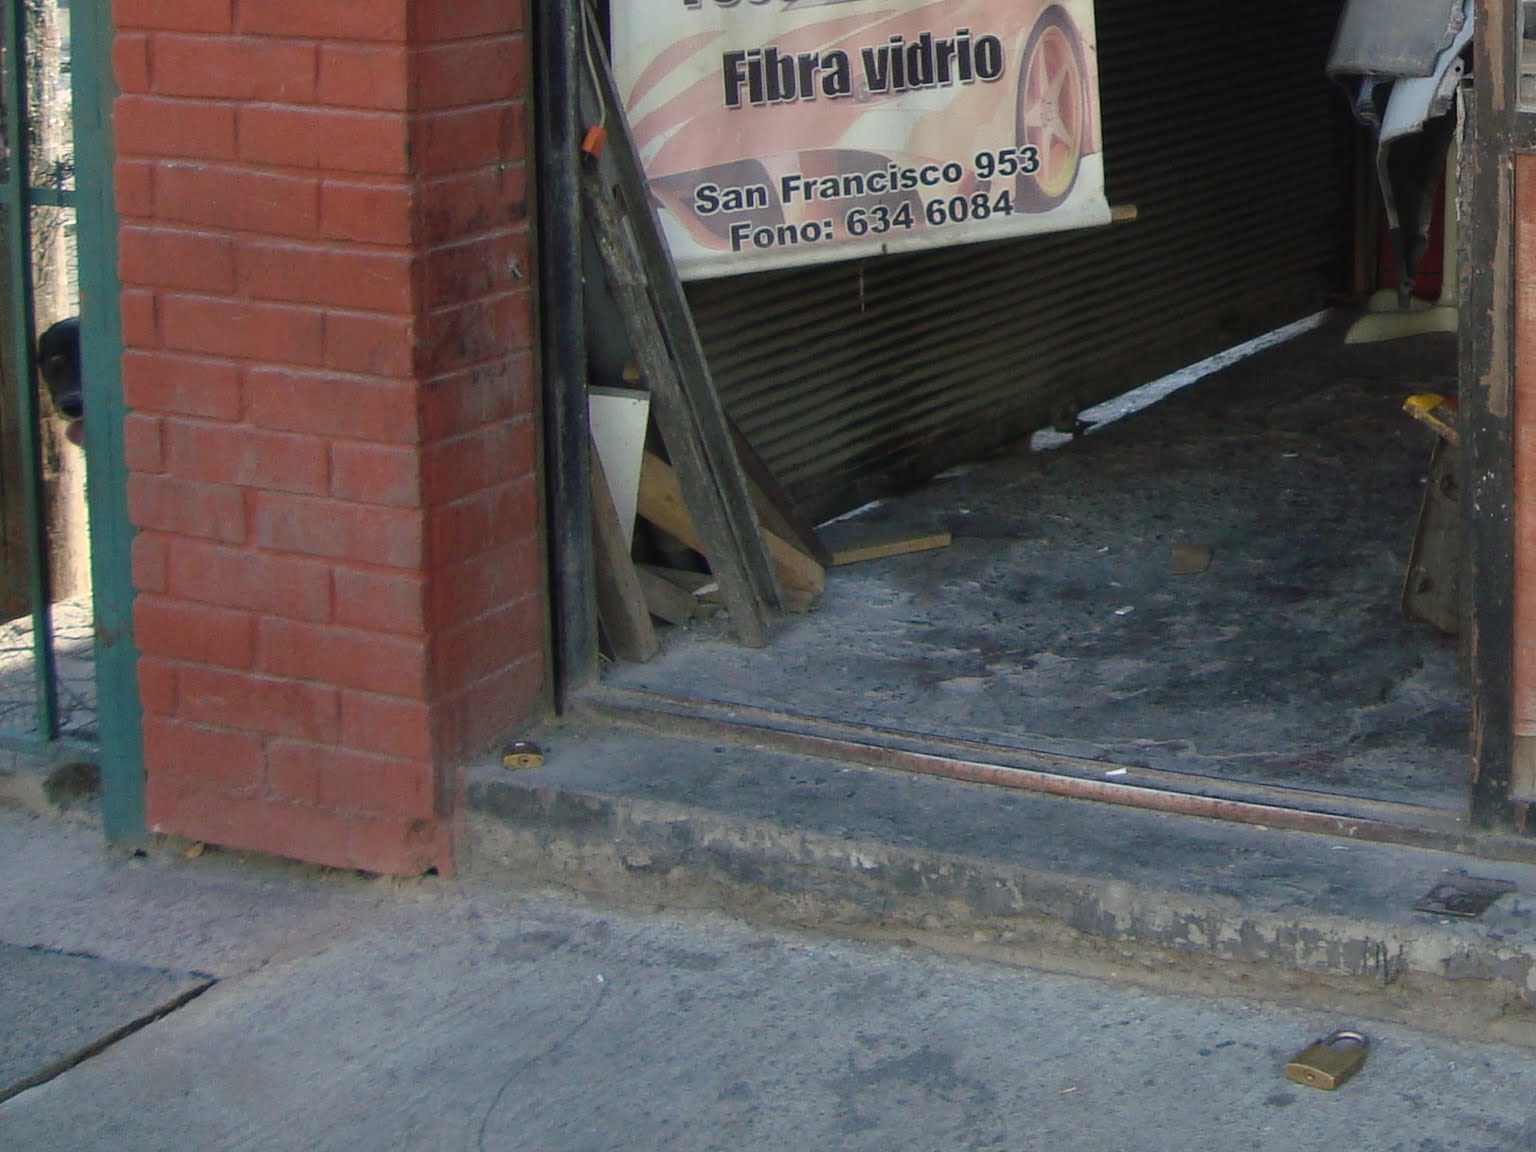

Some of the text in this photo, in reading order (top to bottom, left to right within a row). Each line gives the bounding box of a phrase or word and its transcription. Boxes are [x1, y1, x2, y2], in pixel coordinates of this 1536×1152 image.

[722, 28, 1004, 108] Fibra vidrio
[694, 145, 1041, 215] San Francisco 953
[730, 189, 1014, 253] Fono: 634 6084
